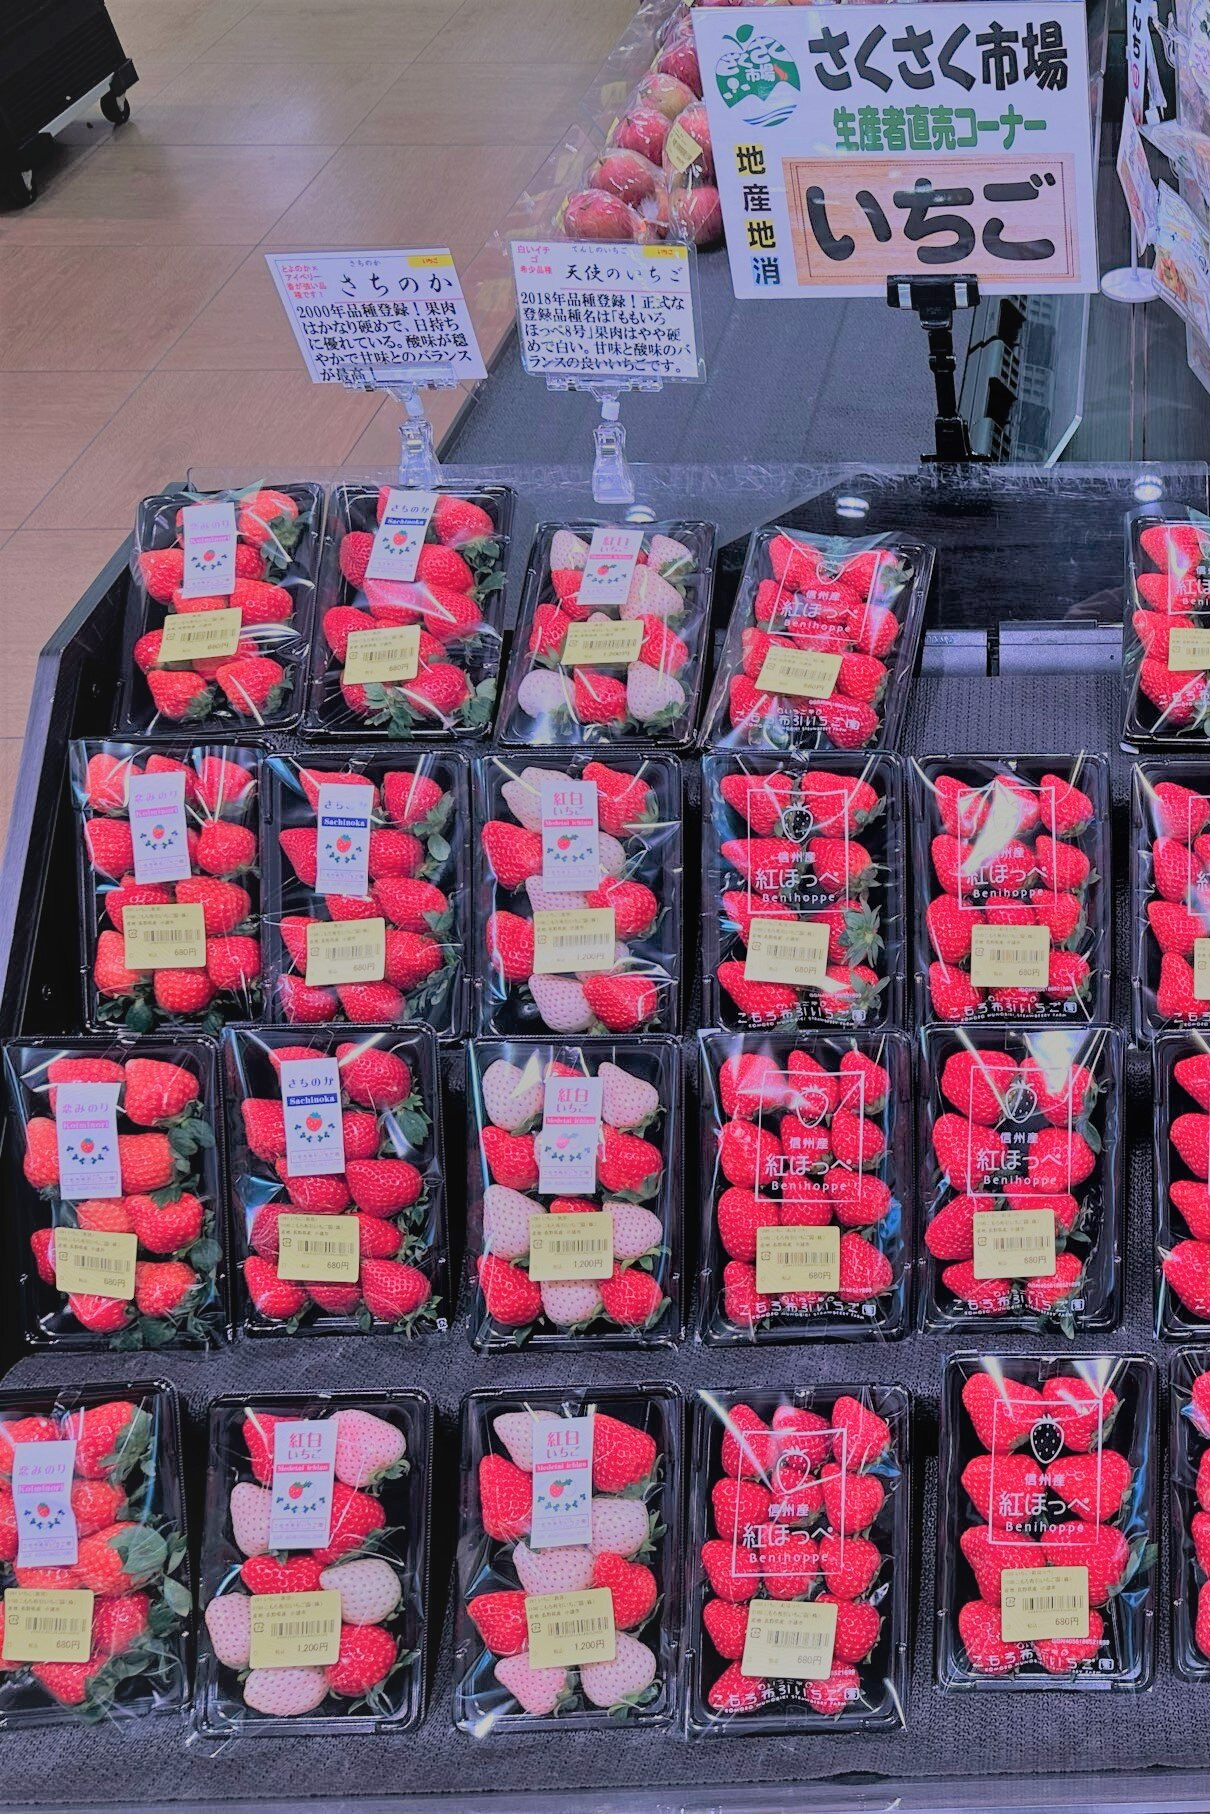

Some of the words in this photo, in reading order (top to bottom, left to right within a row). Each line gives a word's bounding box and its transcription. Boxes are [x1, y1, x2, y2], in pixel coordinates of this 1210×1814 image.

[808, 21, 1068, 92] さくさく市場
[833, 104, 1047, 151] 生産者直売コーナー
[735, 145, 781, 286] 地産地消
[806, 172, 1056, 264] いちご
[566, 264, 683, 282] 天使のいちご
[340, 273, 453, 297] さちのか
[521, 292, 685, 310] 2018年品種登録！正式な
[297, 301, 456, 318] 2000年品種登録！果肉
[524, 308, 665, 325] 登録品種名は「ももいろ
[303, 319, 459, 335] はかなり硬めで、日持ち
[525, 325, 680, 341] ほっぺ8号」果肉はやや硬
[309, 334, 468, 350] に優れている。酸味が穏
[528, 341, 691, 356] めで白い。甘味と酸味のバ
[315, 350, 472, 366] やかで甘味とのバランス
[530, 357, 681, 373] ランスの良いいちごです。
[781, 600, 859, 620] 紅ほっぺ
[784, 618, 852, 633] Benihoppe
[324, 818, 366, 827] Sachinoka
[756, 869, 840, 890] 紅ほっぺ
[966, 864, 1047, 886] 紅ほっぺ
[763, 892, 835, 904] Benihoppe
[973, 887, 1044, 899] Benihoppe
[287, 1077, 335, 1089] さちのか
[289, 1094, 336, 1105] Sachinoka
[558, 1087, 589, 1103] 紅白
[999, 1132, 1038, 1144] 信州産
[765, 1153, 852, 1176] 紅ほっぺ
[977, 1149, 1062, 1171] 紅ほっぺ
[771, 1180, 846, 1192] Benihoppe
[984, 1174, 1057, 1187] Benihoppe
[326, 1261, 349, 1271] 680円
[289, 1432, 322, 1448] 紅白
[546, 1430, 578, 1447] 紅白
[546, 1446, 579, 1459] いちご
[1025, 1473, 1065, 1487] 信州産
[768, 1503, 809, 1517] 信州産
[999, 1491, 1090, 1517] 紅ほっぺ
[1005, 1521, 1084, 1533] Benihoppe
[743, 1523, 835, 1548] 紅ほっぺ
[749, 1552, 829, 1564] Benihoppe
[1055, 1617, 1080, 1626] 680円
[56, 1640, 80, 1650] 680円
[574, 1639, 606, 1650] 1,200円
[797, 1655, 822, 1665] 680円
